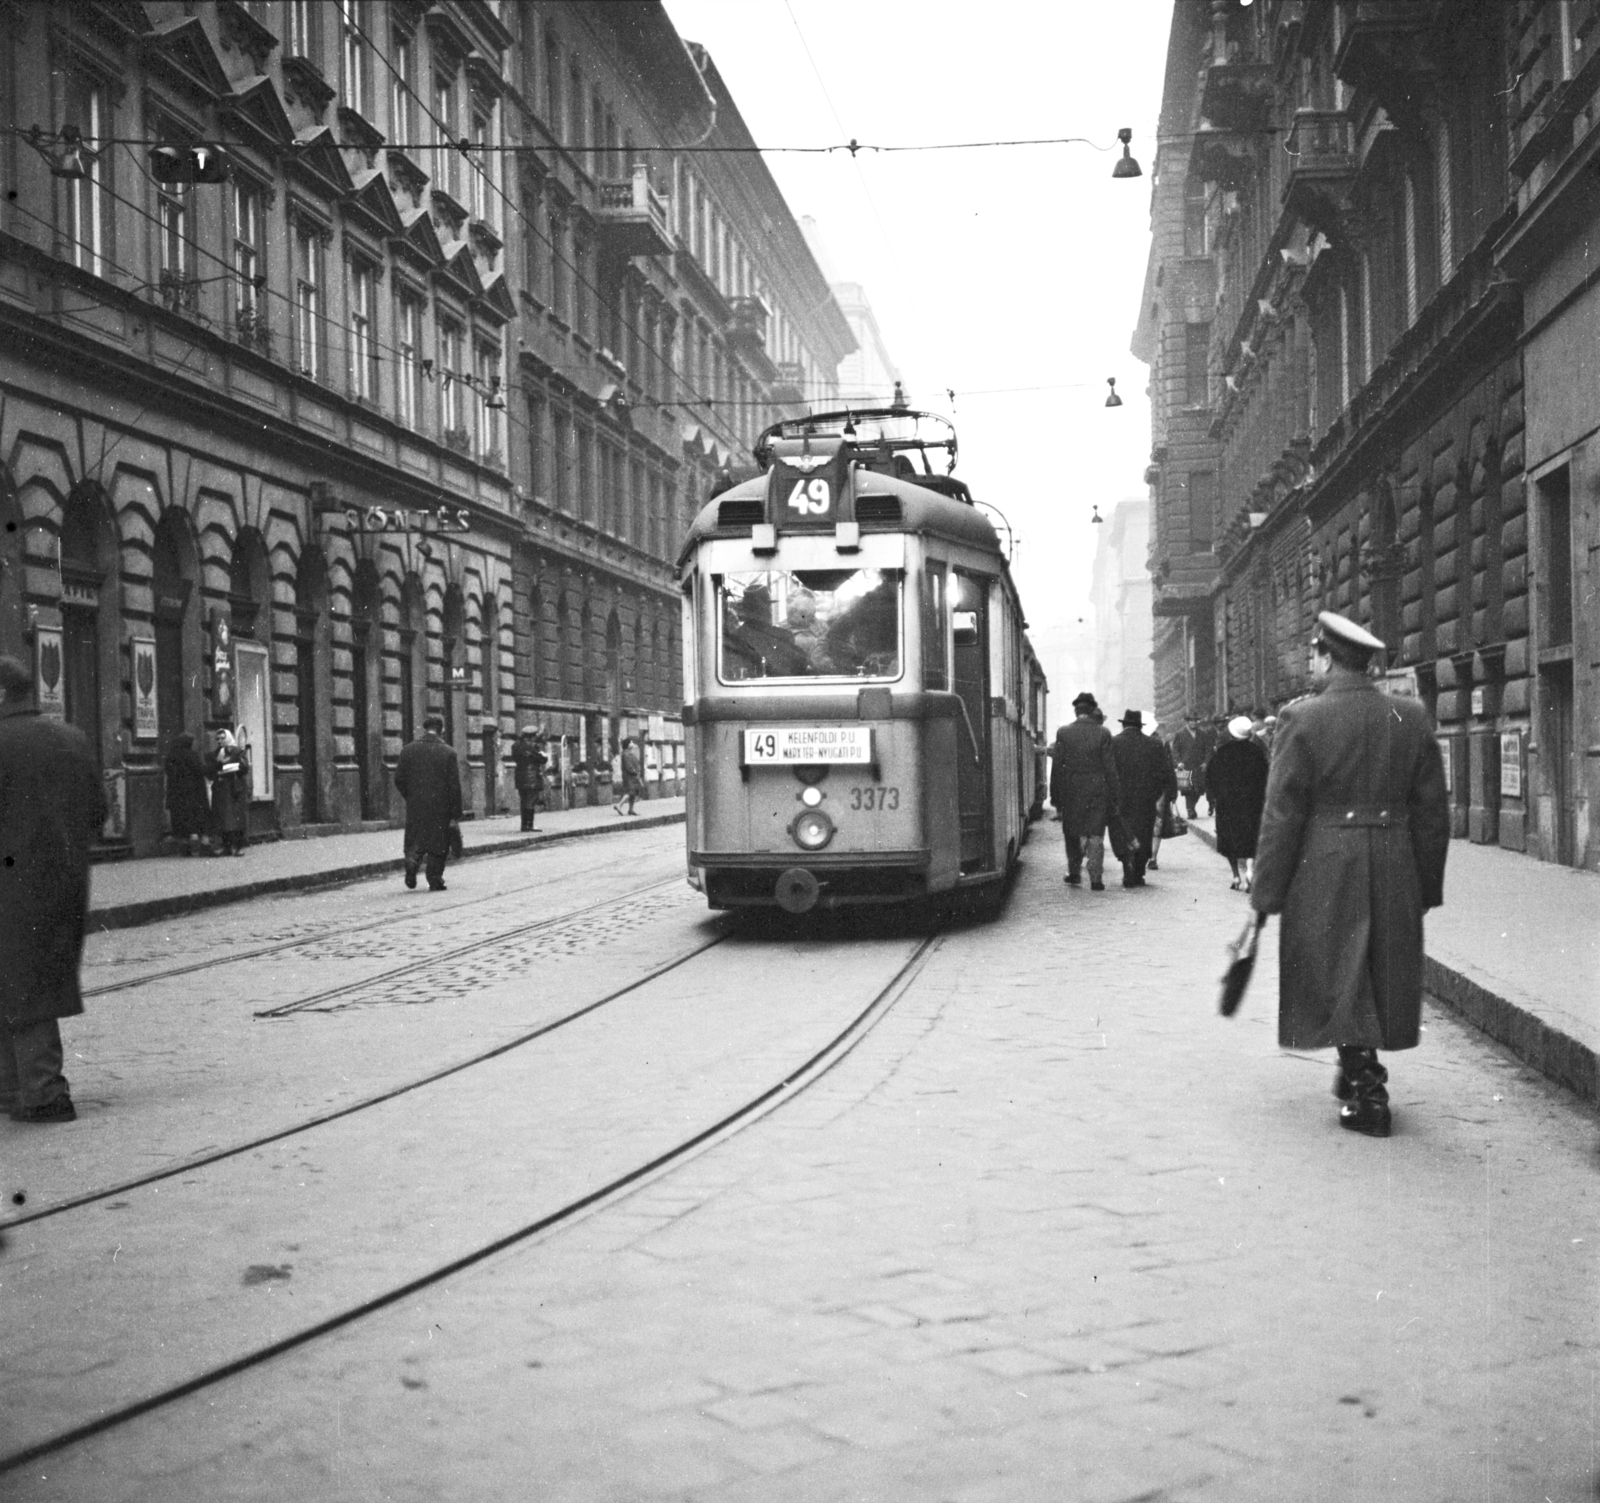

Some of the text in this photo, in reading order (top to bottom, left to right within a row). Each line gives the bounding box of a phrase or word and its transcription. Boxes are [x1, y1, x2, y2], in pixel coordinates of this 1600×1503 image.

[788, 478, 830, 515] 49
[754, 734, 776, 757] 49
[782, 746, 801, 759] MARX
[850, 786, 900, 811] 3373
